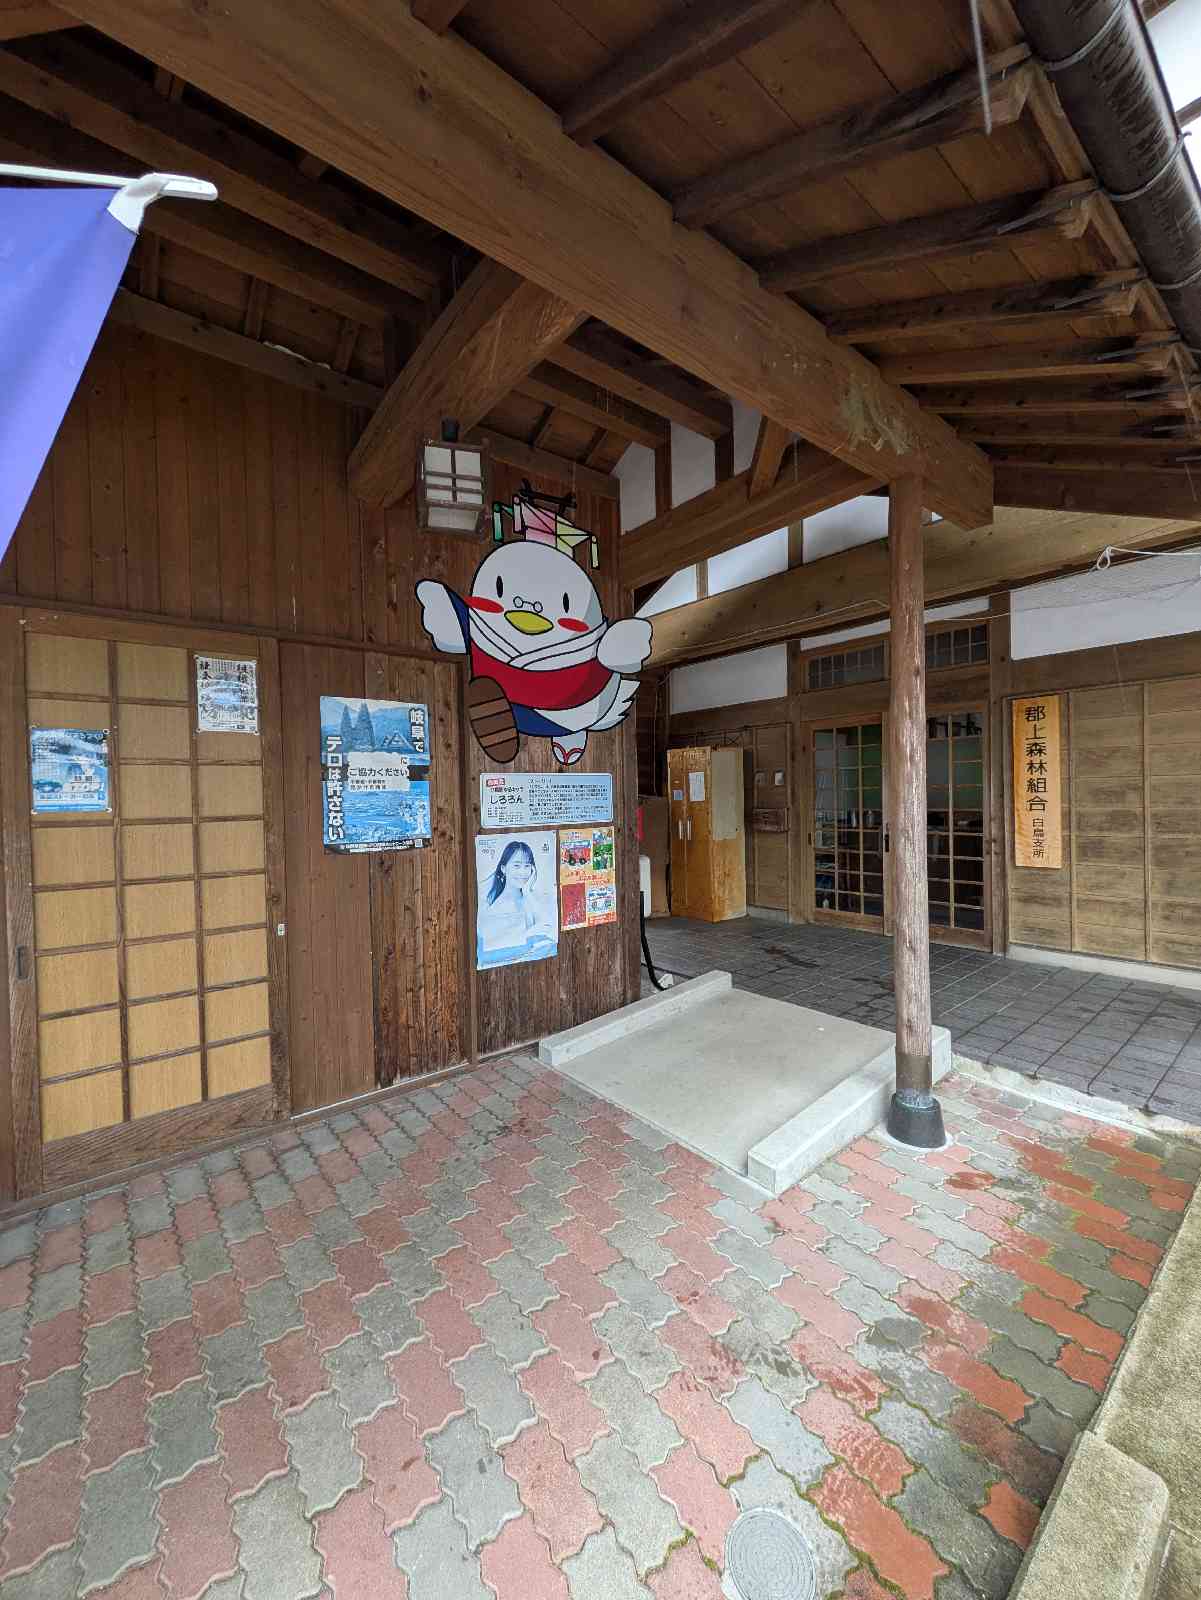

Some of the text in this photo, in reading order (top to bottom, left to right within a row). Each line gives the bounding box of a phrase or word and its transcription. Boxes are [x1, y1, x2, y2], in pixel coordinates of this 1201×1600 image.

[410, 709, 425, 752] 岐阜で
[1024, 705, 1048, 859] 郡上森林組合 白鳥支所
[326, 736, 344, 841] テロは許さない
